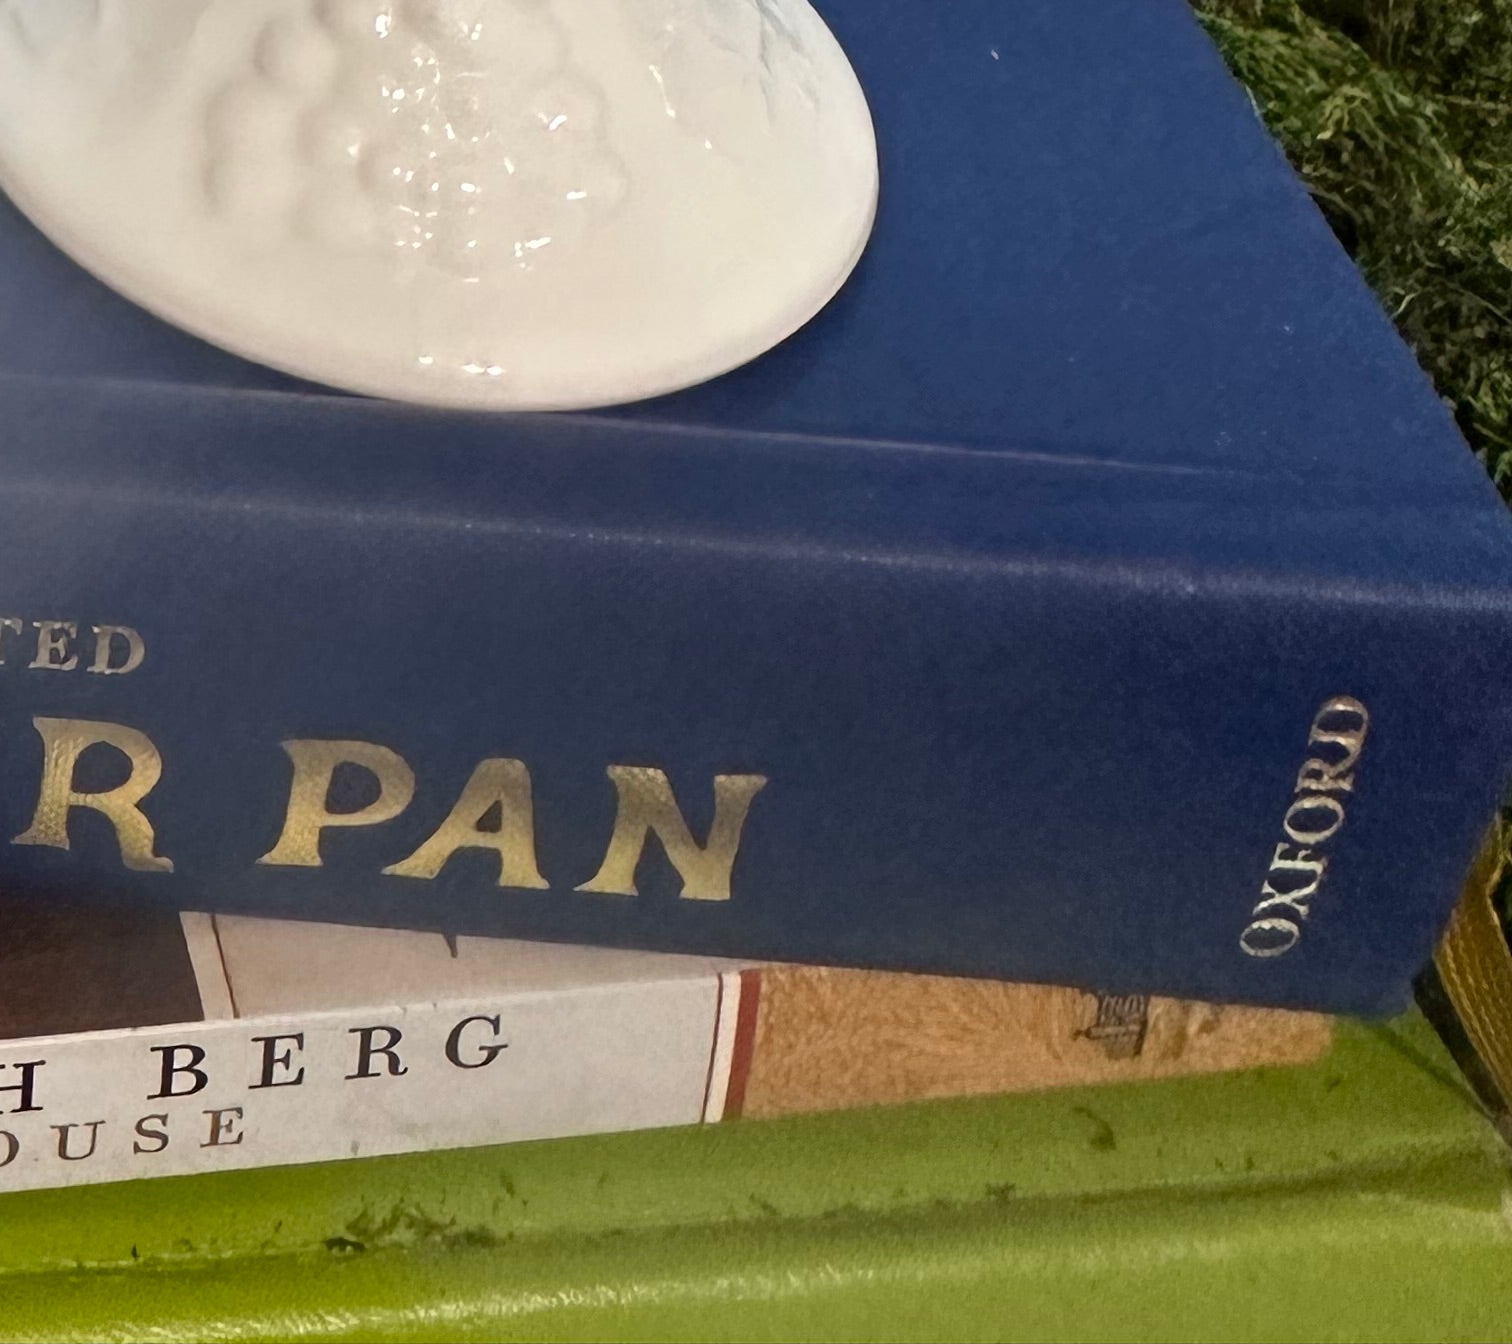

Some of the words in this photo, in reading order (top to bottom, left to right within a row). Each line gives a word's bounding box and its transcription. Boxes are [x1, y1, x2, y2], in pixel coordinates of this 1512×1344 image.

[256, 738, 768, 902] PAN
[1239, 695, 1369, 958] OXFORD
[147, 1014, 509, 1100] BERG
